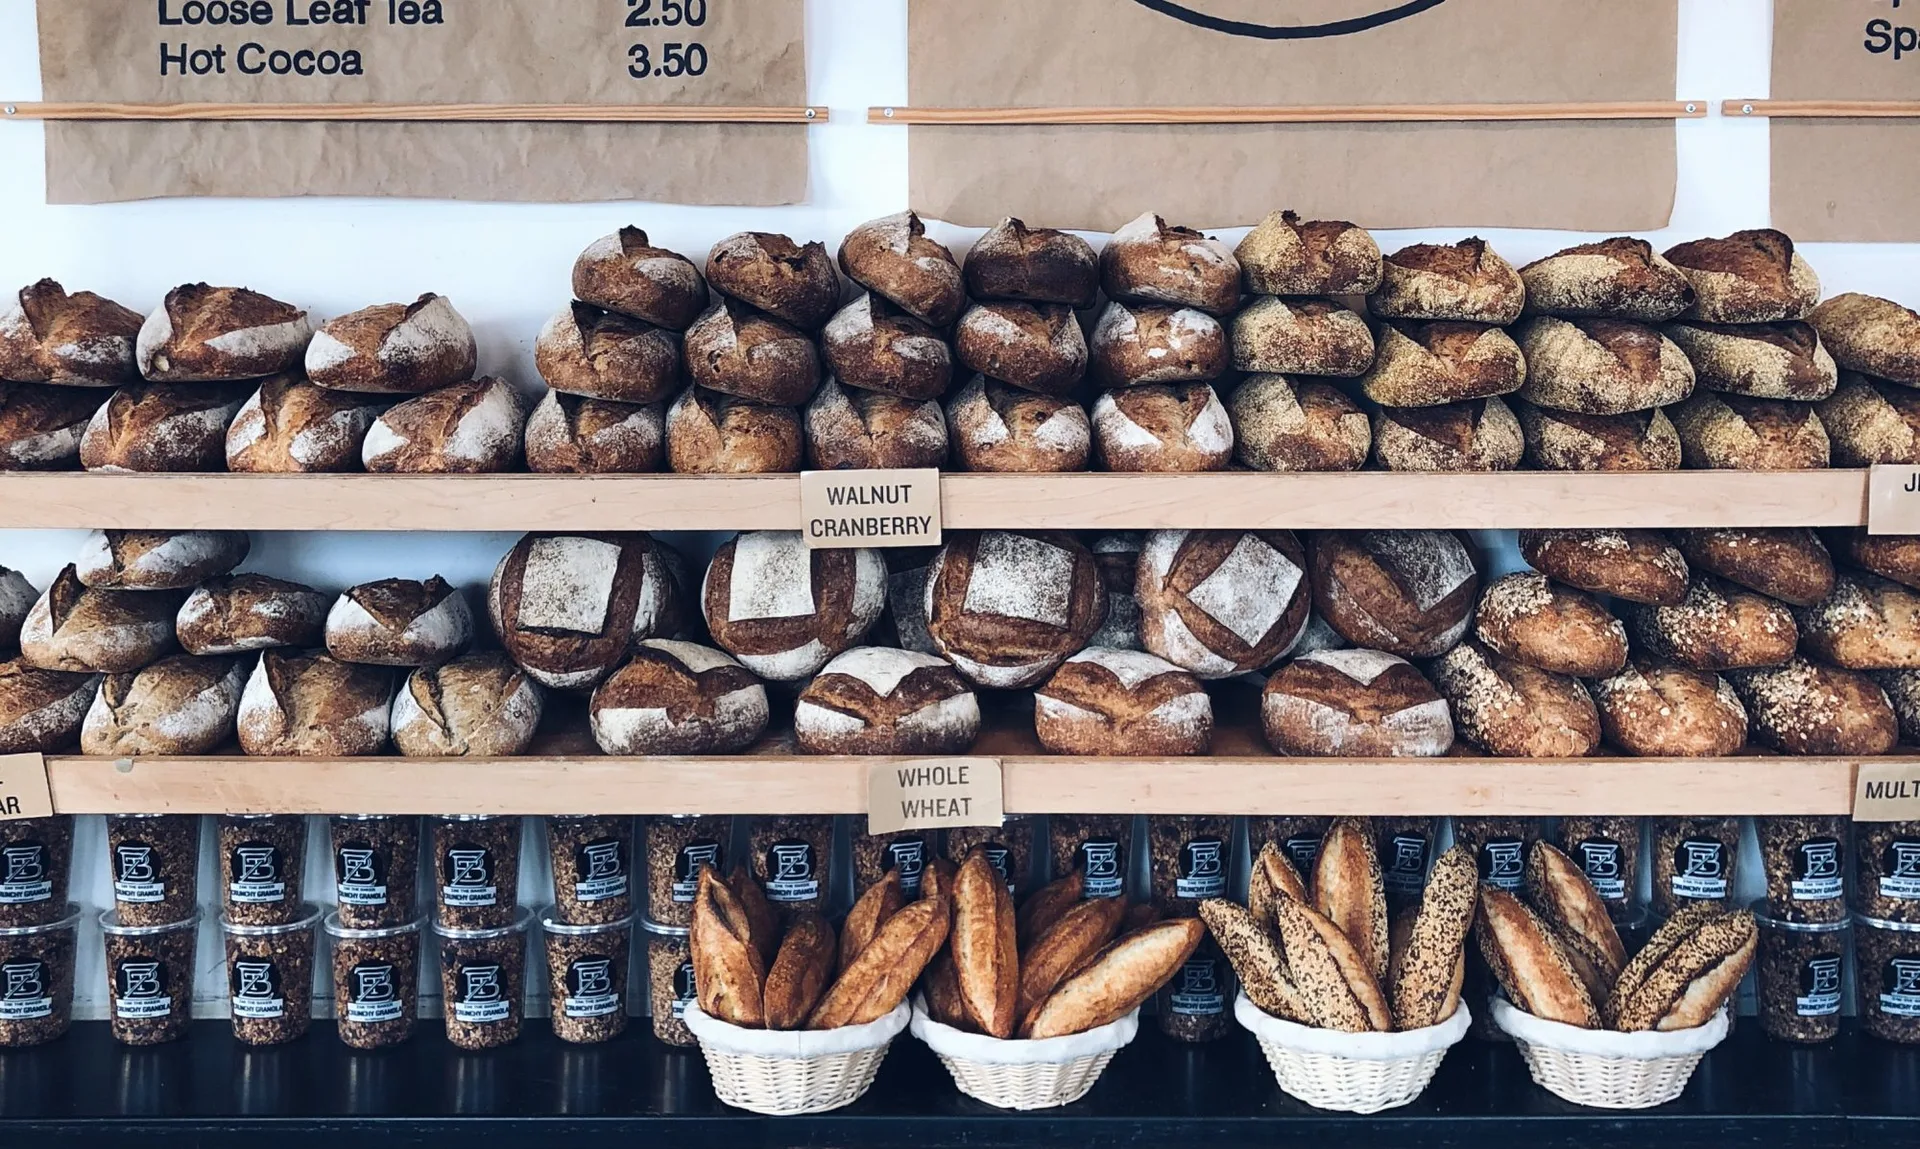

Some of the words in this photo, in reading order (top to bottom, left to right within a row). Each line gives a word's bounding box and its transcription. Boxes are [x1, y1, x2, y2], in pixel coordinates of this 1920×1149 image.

[158, 0, 273, 25] Loose
[286, 0, 371, 25] Leaf
[625, 0, 706, 27] 2.50
[1864, 19, 1920, 60] Sp
[160, 43, 227, 76] Hot
[237, 43, 363, 76] Cocoa
[628, 43, 708, 78] 3.50
[1904, 473, 1920, 492] J
[826, 485, 912, 505] WALNUT
[810, 516, 932, 537] CRANBERRY
[898, 766, 969, 788] WHOLE
[1866, 781, 1920, 799] MULT
[901, 798, 972, 818] WHEAT
